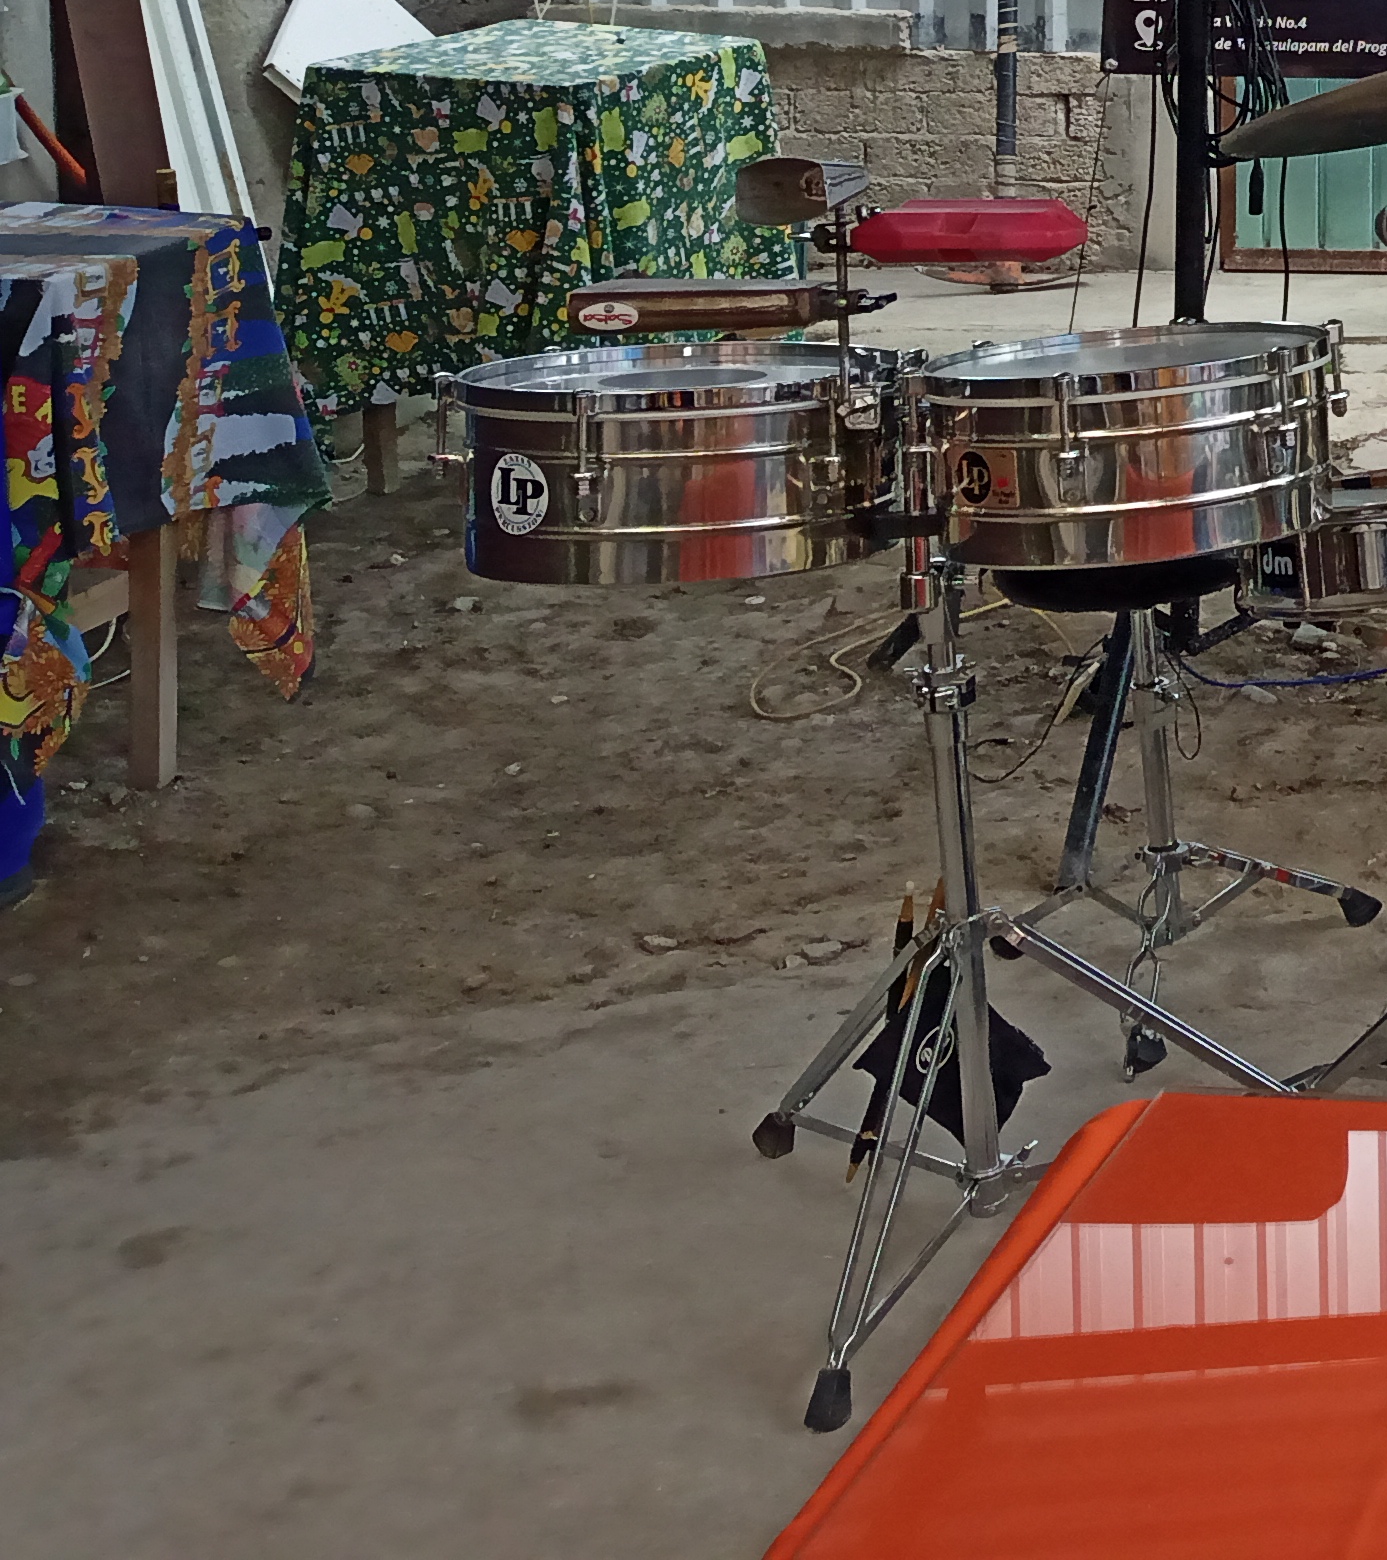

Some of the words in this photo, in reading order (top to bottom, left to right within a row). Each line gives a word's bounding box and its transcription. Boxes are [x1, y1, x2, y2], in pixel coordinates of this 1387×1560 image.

[1275, 15, 1308, 30] No.4
[1214, 38, 1232, 51] de
[1332, 39, 1354, 53] del
[497, 466, 545, 517] LP
[961, 460, 989, 495] LP
[1263, 547, 1294, 576] dm
